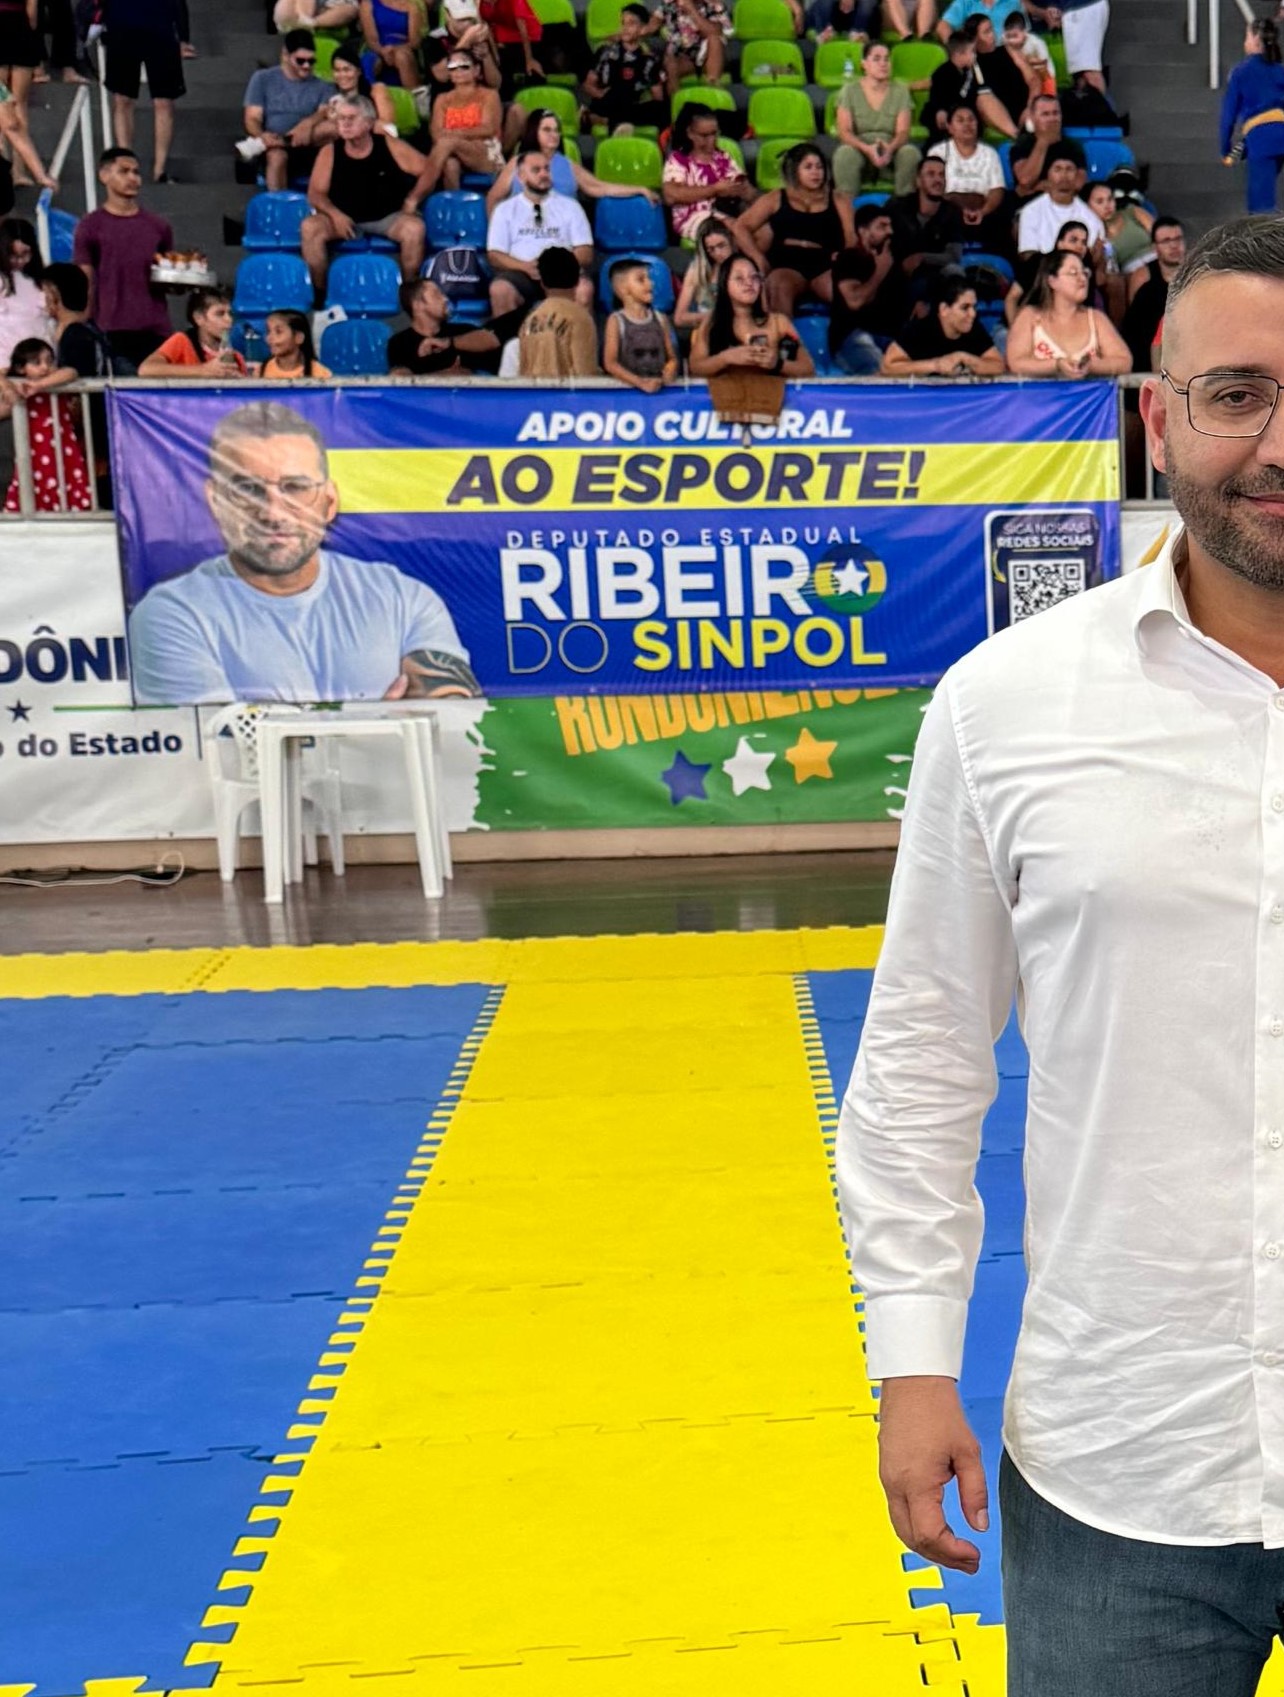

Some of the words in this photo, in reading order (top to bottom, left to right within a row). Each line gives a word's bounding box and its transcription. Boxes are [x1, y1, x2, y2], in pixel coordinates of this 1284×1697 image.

[516, 411, 646, 442] APOIO
[445, 454, 554, 505] AO
[571, 450, 926, 505] ESPORTE!
[506, 529, 681, 549] DEPUTADO
[700, 526, 863, 547] ESTADUAL
[996, 534, 1041, 549] REDES
[506, 620, 609, 675] DO
[632, 616, 888, 673] SINPOL
[17, 732, 59, 758] do
[69, 730, 183, 756] Estado
